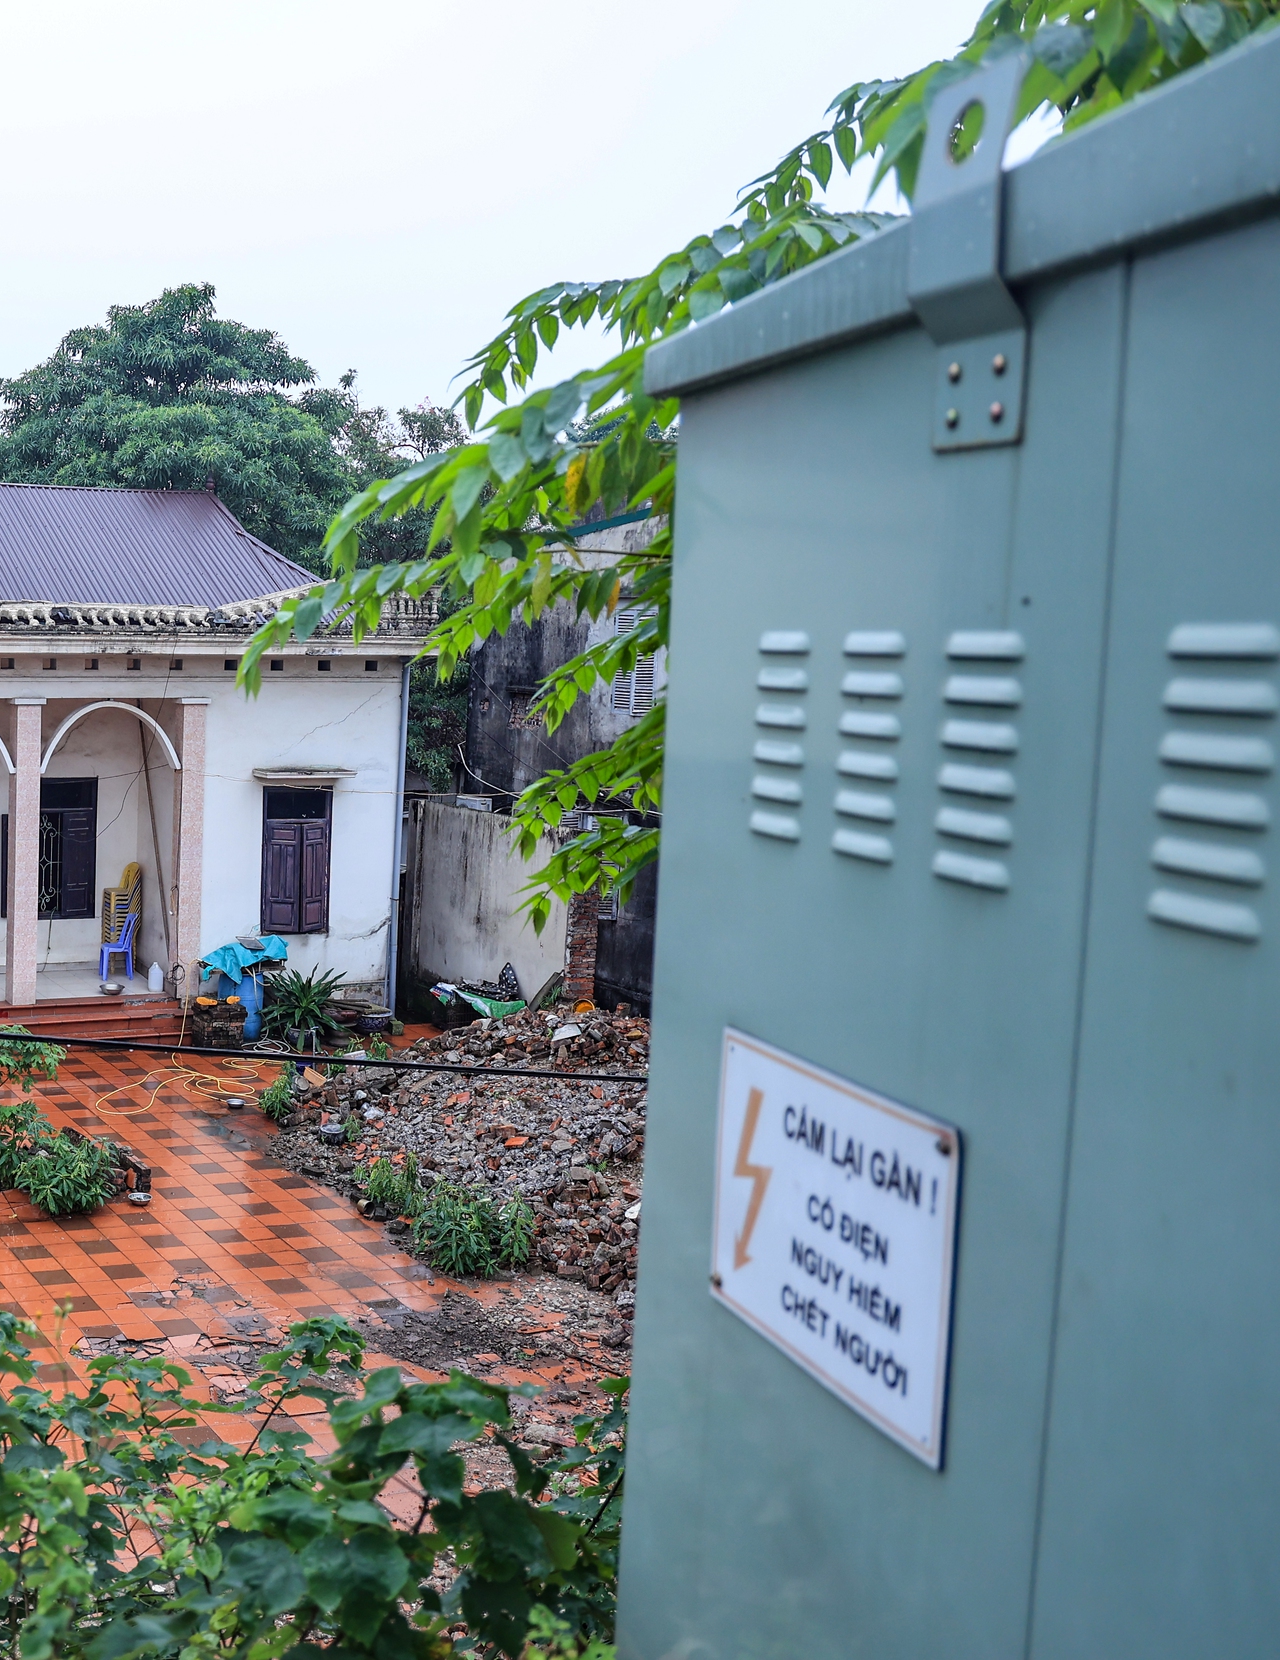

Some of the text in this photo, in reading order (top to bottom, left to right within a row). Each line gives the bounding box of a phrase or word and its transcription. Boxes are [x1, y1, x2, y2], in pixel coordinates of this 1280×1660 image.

[831, 1128, 863, 1180] LẠI
[808, 1194, 888, 1266] CÓ ĐIỆN
[790, 1238, 844, 1292] NGUY
[782, 1284, 908, 1397] CHẾT NGƯỜI
